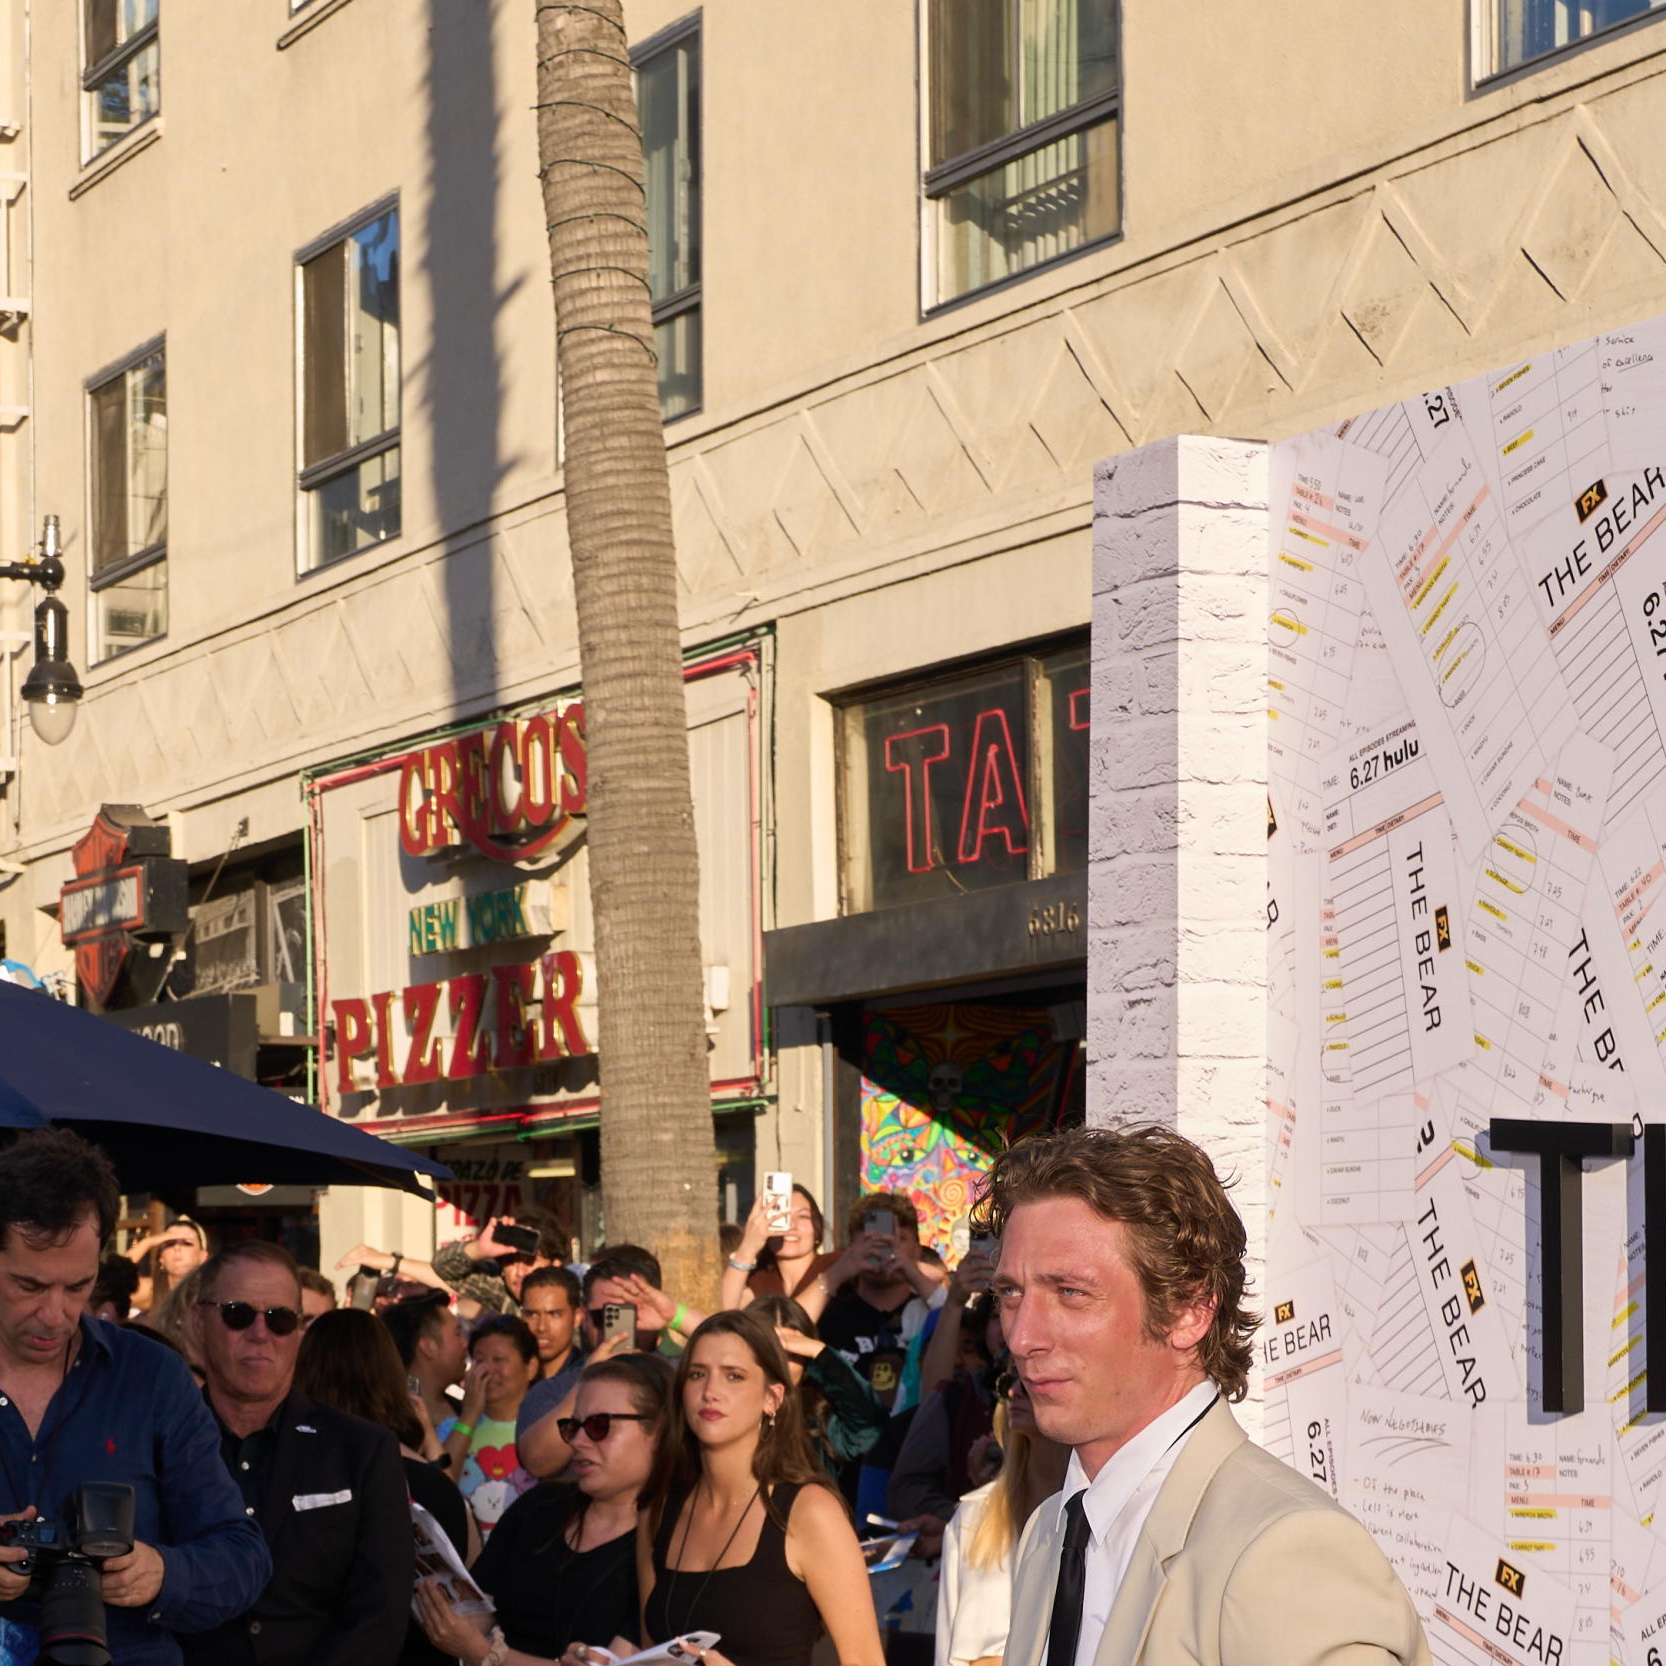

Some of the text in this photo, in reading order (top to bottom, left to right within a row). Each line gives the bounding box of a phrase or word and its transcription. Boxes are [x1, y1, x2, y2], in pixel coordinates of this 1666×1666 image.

[1538, 466, 1665, 607] THE BEAR
[1349, 738, 1419, 790] 6.27 hulu
[409, 886, 529, 954] NEW YORK
[1406, 841, 1441, 1033] THE BEAR
[1446, 1561, 1488, 1621] THE
